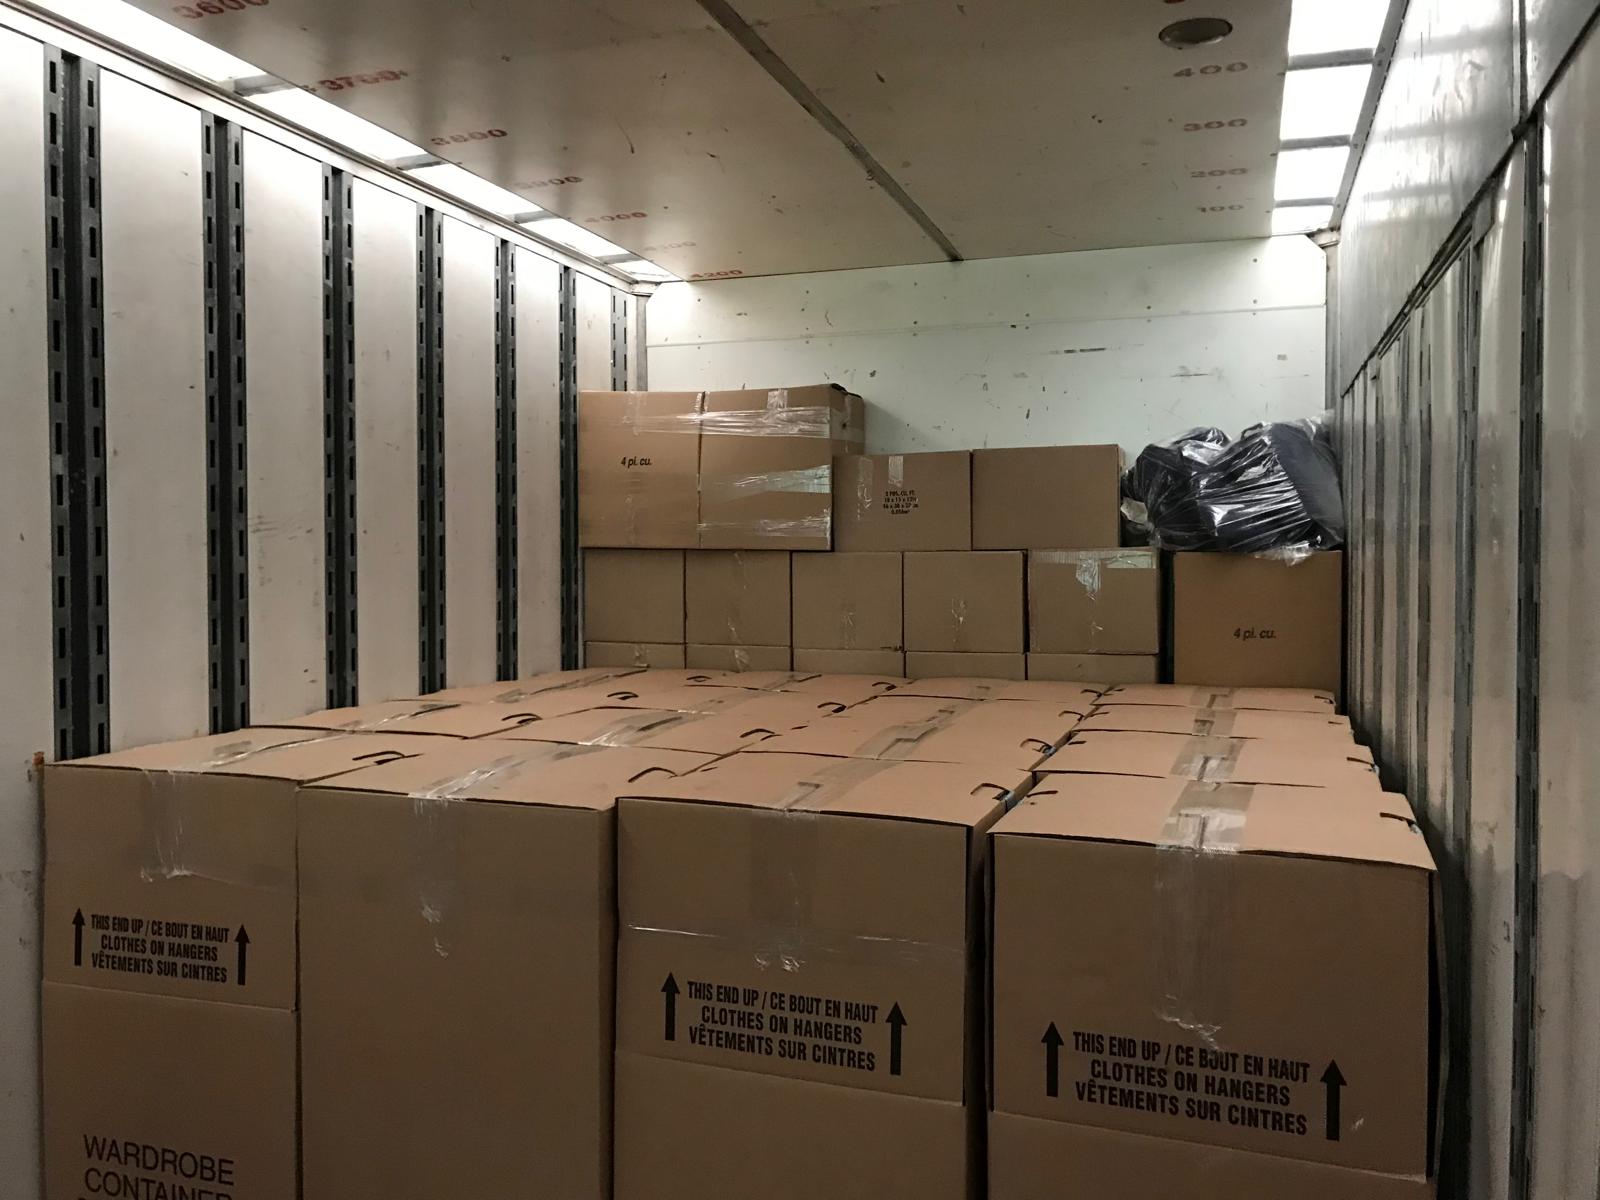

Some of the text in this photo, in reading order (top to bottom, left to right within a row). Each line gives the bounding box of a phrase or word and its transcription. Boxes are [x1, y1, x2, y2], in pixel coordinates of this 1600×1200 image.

[1173, 62, 1248, 77] 400
[1183, 118, 1248, 131] 300
[1190, 167, 1248, 178] 200
[584, 211, 648, 224] 4000
[1197, 204, 1244, 213] 100
[690, 269, 743, 278] 4200
[620, 456, 626, 466] 4
[639, 457, 653, 466] cu.
[1233, 628, 1240, 639] 4
[1259, 629, 1277, 639] cu.
[91, 915, 229, 943] THIS END UP / CE BOUT EN HAUT
[101, 934, 218, 962] CLOTHES ON HANGERS
[92, 951, 226, 982] VÊTEMENTS SUR CINTRES
[688, 981, 878, 1023] THIS END UP / CE BOUT EN HAUT
[702, 1006, 861, 1044] CLOTHES ON HANGERS
[689, 1024, 875, 1071] VÊTEMENTS SUR CINTRES
[1073, 1031, 1309, 1083] THIS END UP / CE BOUT EN HAUT
[1091, 1060, 1290, 1106] CLOTHES ON HANGERS
[1076, 1079, 1307, 1135] VÊTEMENTS SUR CINTRES
[84, 1134, 234, 1186] WARDROBE
[84, 1168, 232, 1200] CONTAIN
